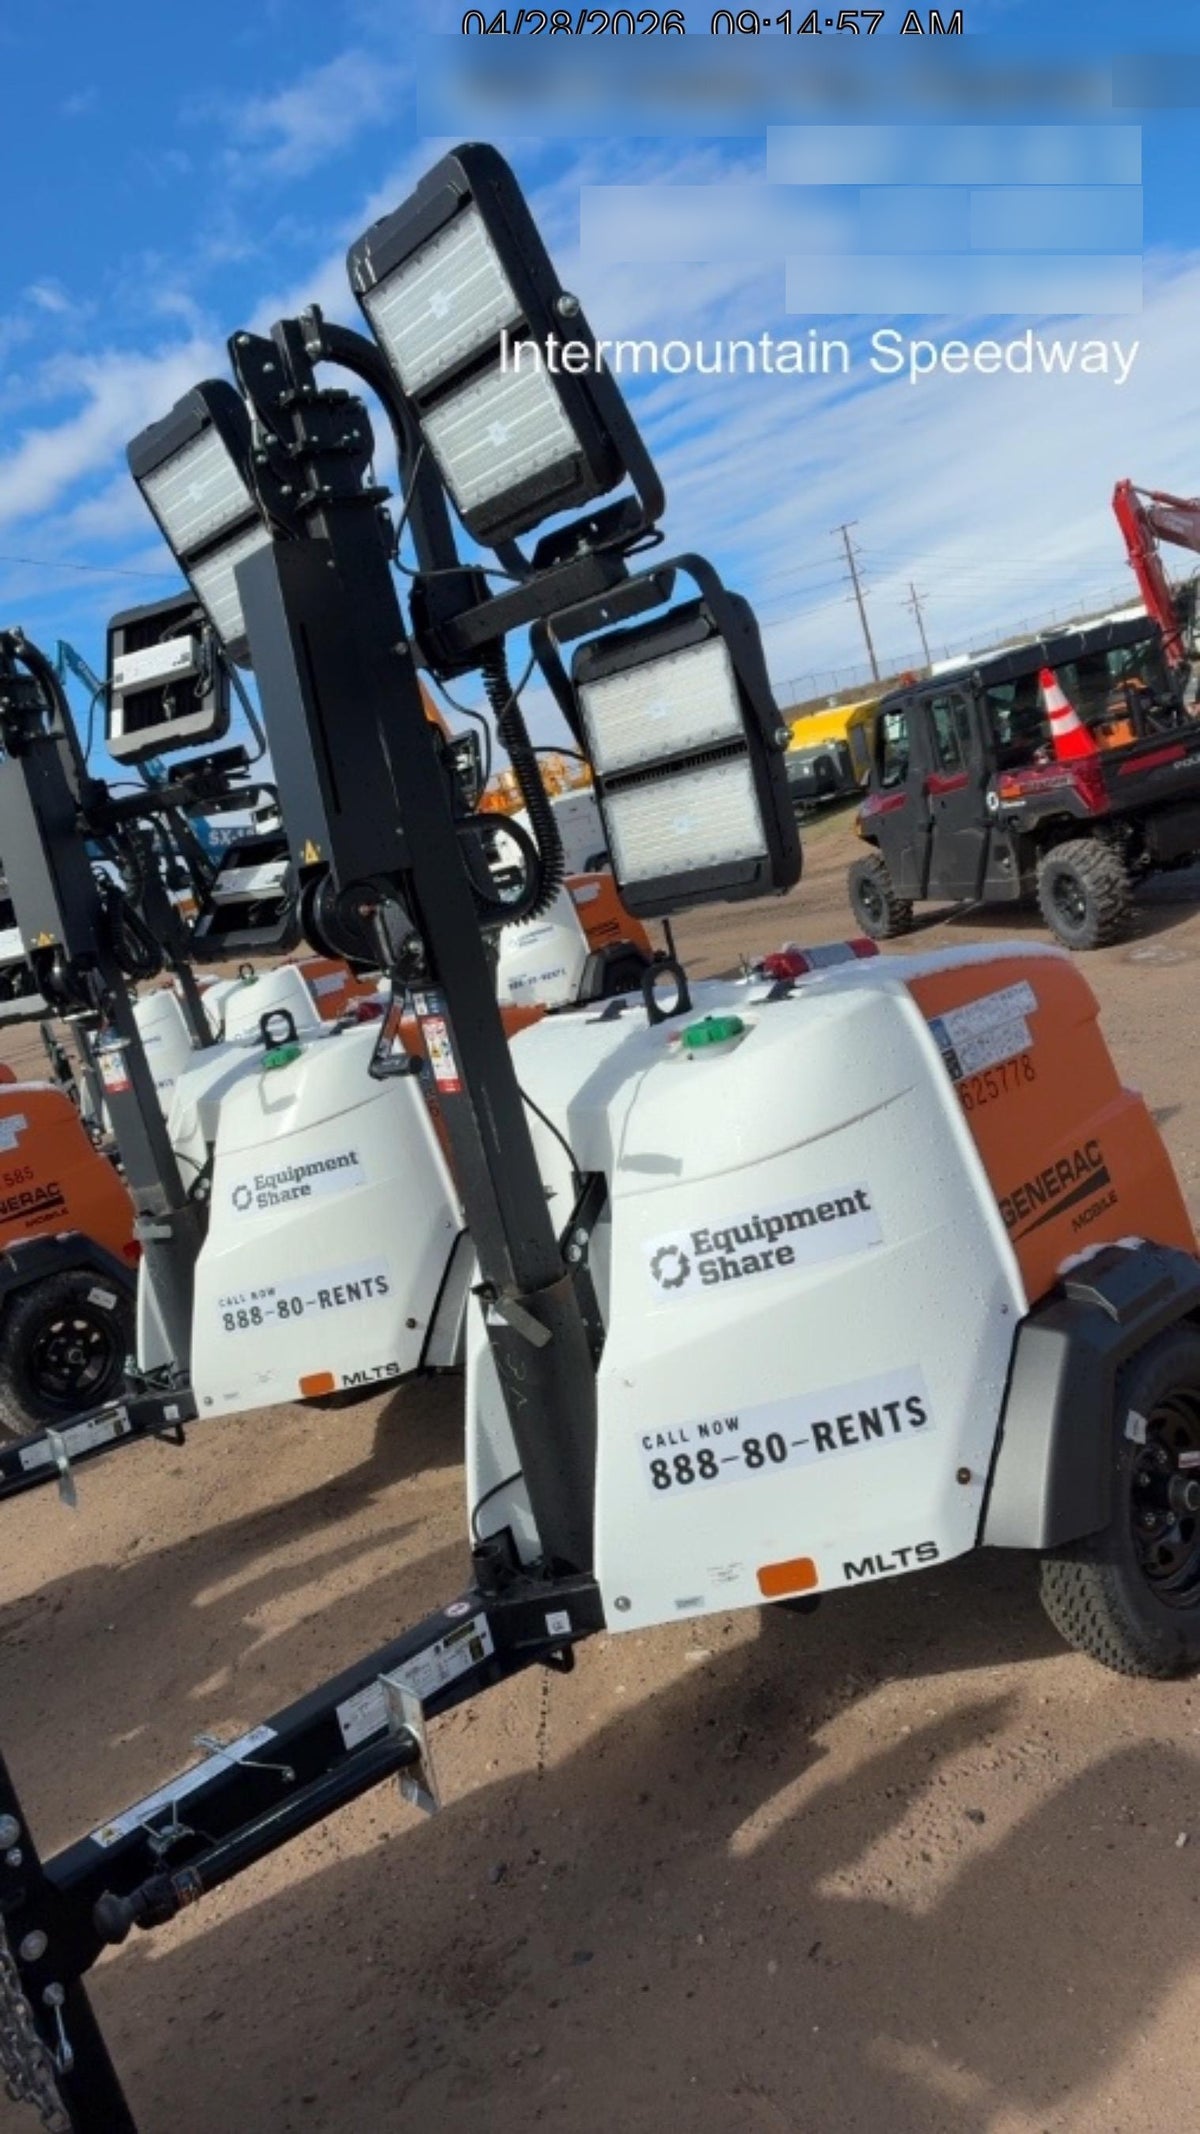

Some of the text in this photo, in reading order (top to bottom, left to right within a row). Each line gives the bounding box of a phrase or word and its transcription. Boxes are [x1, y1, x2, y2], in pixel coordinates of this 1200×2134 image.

[960, 1054, 1036, 1111] 625778
[254, 1150, 359, 1191] Equipment
[999, 1140, 1104, 1229] GENERAC
[256, 1183, 311, 1209] Share
[1071, 1189, 1118, 1233] MOBILE
[690, 1188, 871, 1256] Equipment
[697, 1244, 795, 1286] Share
[222, 1275, 390, 1331] 888-80-RENTS
[342, 1361, 400, 1387] MLTS
[642, 1416, 740, 1450] CALL NOW
[650, 1395, 928, 1490] 888-80-RENTS
[842, 1540, 940, 1580] MLTS
